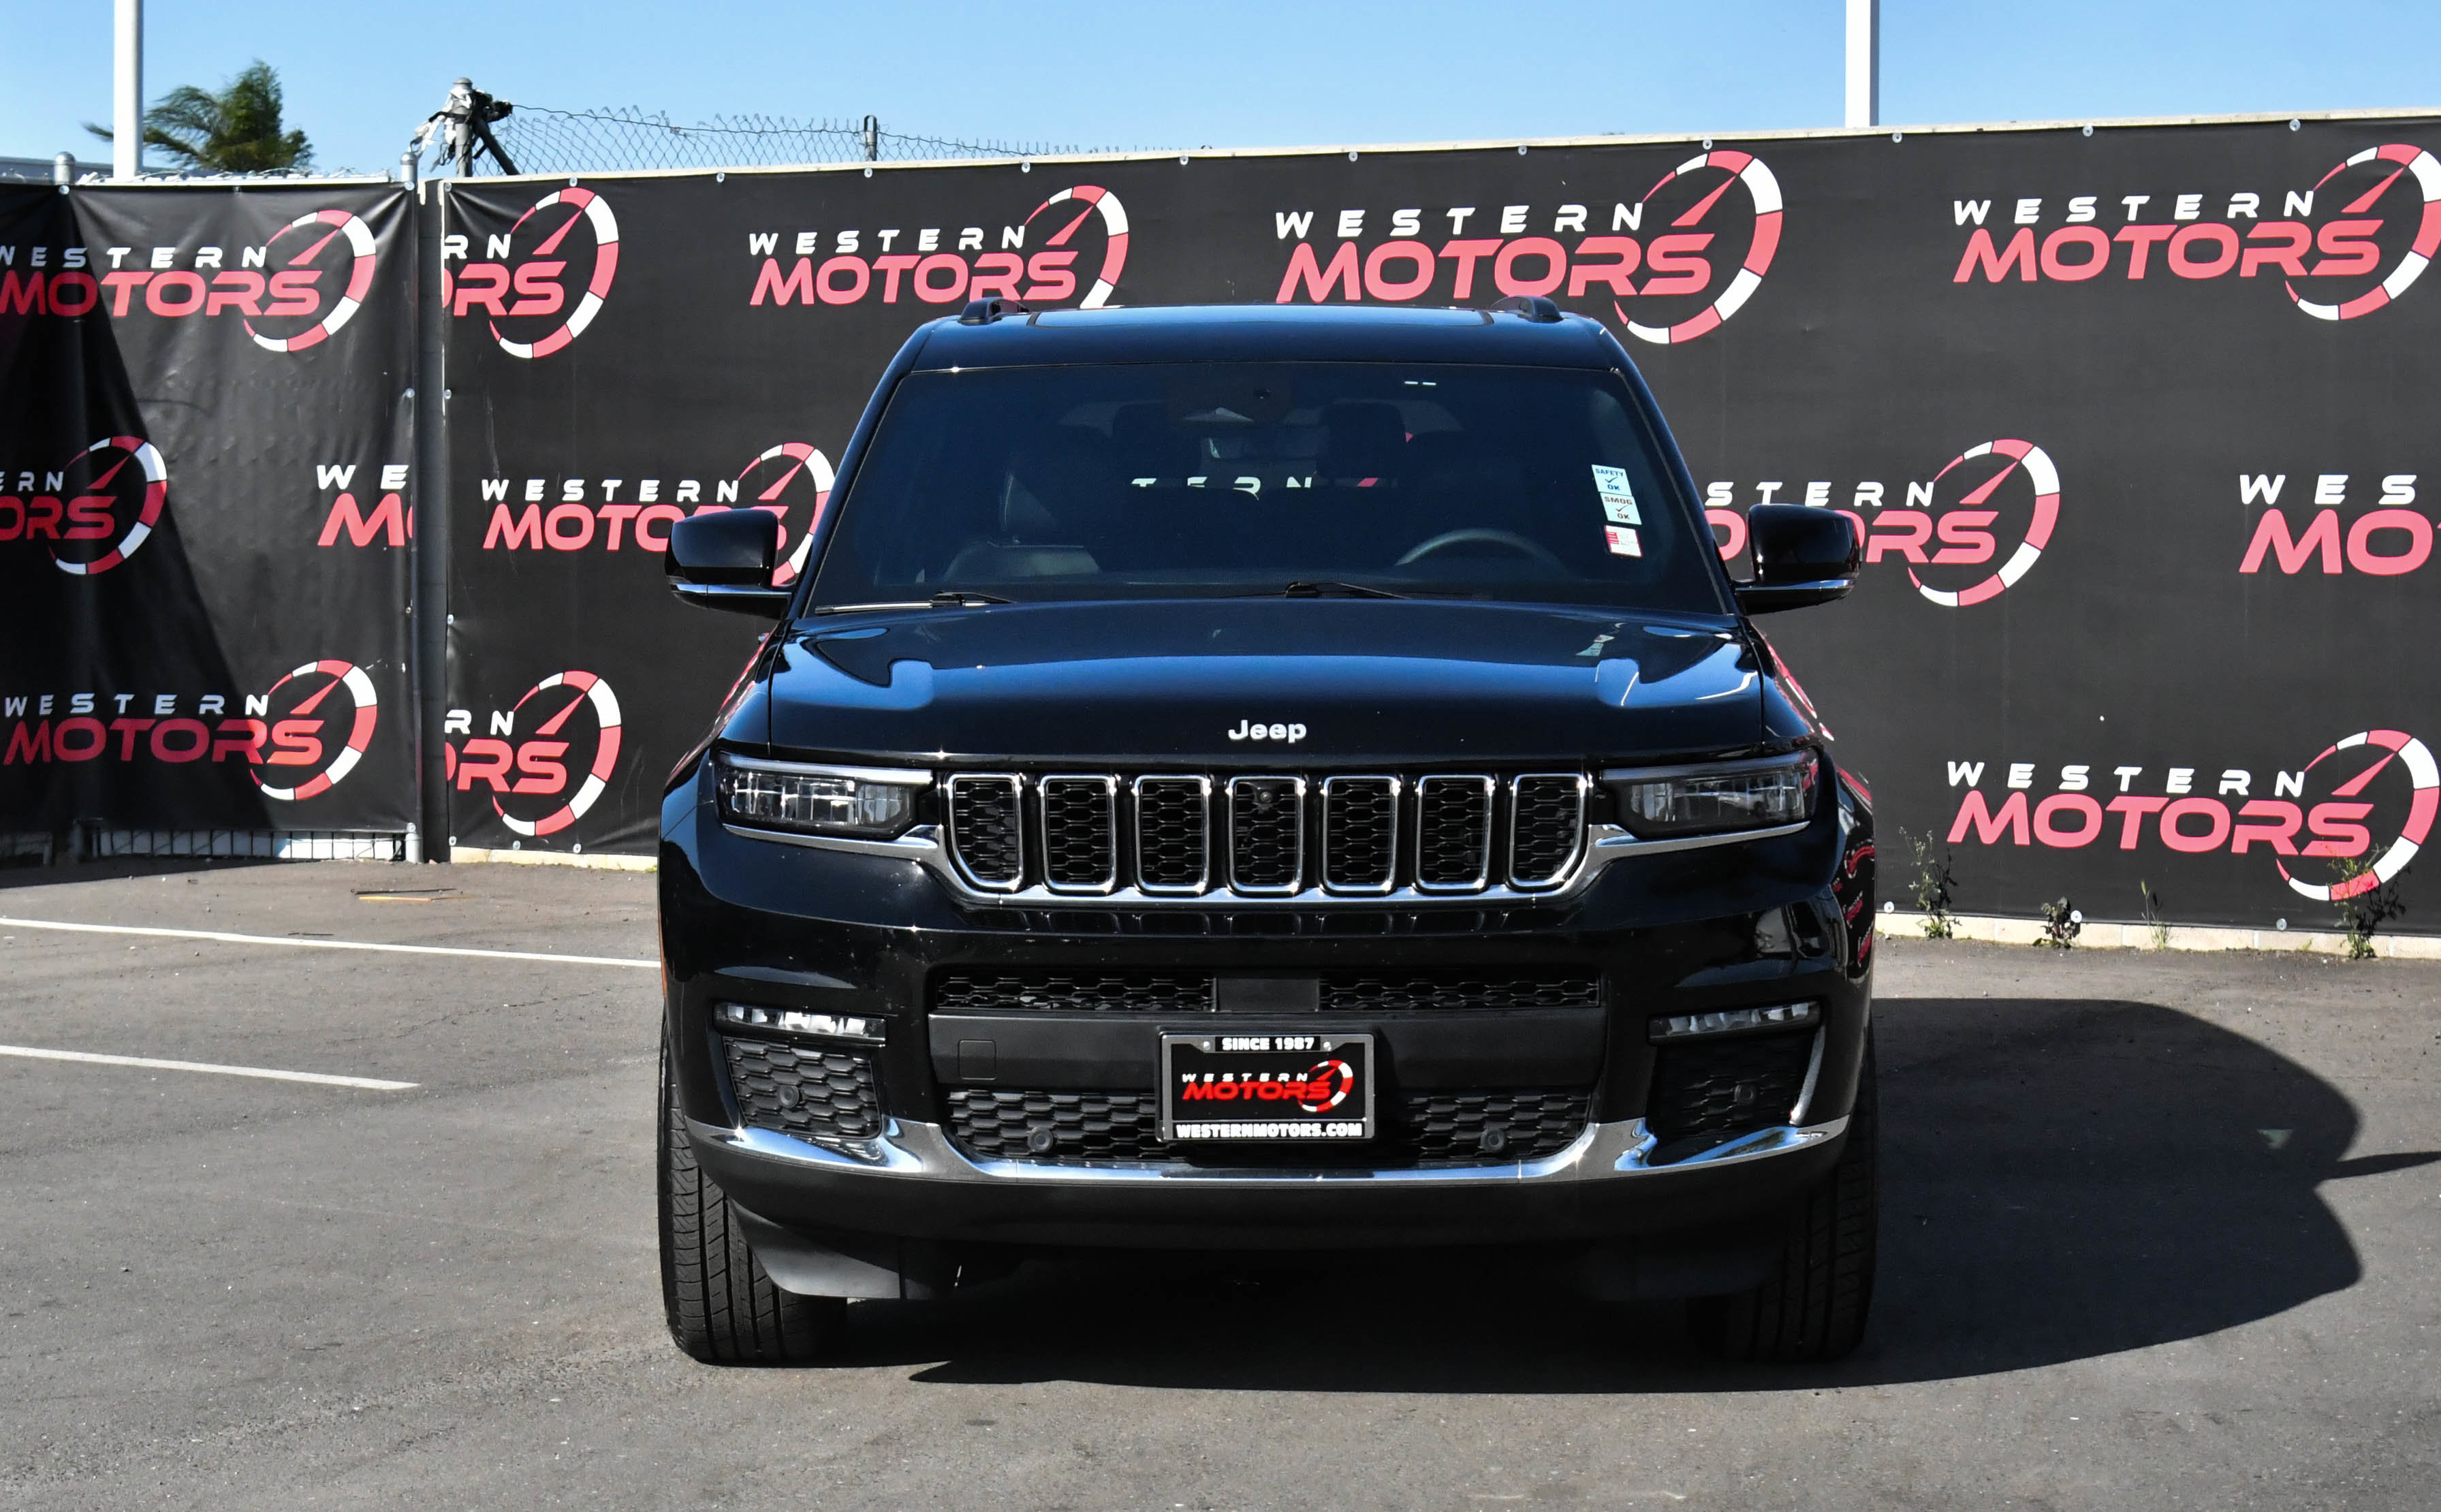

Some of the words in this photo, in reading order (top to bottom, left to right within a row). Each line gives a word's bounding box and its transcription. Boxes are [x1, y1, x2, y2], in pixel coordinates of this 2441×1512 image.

[1276, 202, 1643, 240] WESTERN
[1954, 190, 2314, 225] WESTERN
[444, 234, 510, 259] RN
[749, 225, 1024, 255] WESTERN
[1953, 219, 2384, 283] MOTORS
[750, 251, 1079, 306] MOTORS
[1276, 233, 1715, 304] MOTORS
[0, 270, 323, 317] MOTORS
[443, 260, 567, 317] RS
[317, 464, 409, 490] WE
[1595, 468, 1624, 477] SAFETY
[482, 479, 738, 502] WESTERN
[1604, 496, 1633, 505] SMOG
[1705, 482, 1934, 506] STERN
[2239, 474, 2417, 505] WES
[317, 492, 413, 548] M
[482, 503, 789, 552] MOTO
[2239, 508, 2441, 576] MO
[5, 693, 269, 717] WESTERN
[445, 710, 514, 736] RN
[1228, 719, 1307, 744] Jeep
[4, 717, 324, 766] MOTORS
[445, 739, 569, 793] RS
[1947, 761, 2304, 797] WESTERN
[1947, 790, 2374, 857] MOTORS
[1222, 1037, 1271, 1050] SINCE
[1275, 1037, 1315, 1050] 1987
[1182, 1073, 1308, 1083] WESTERN
[1182, 1081, 1332, 1101] MOTORS
[1176, 1124, 1363, 1138] WESTERNMOTORS.COM
